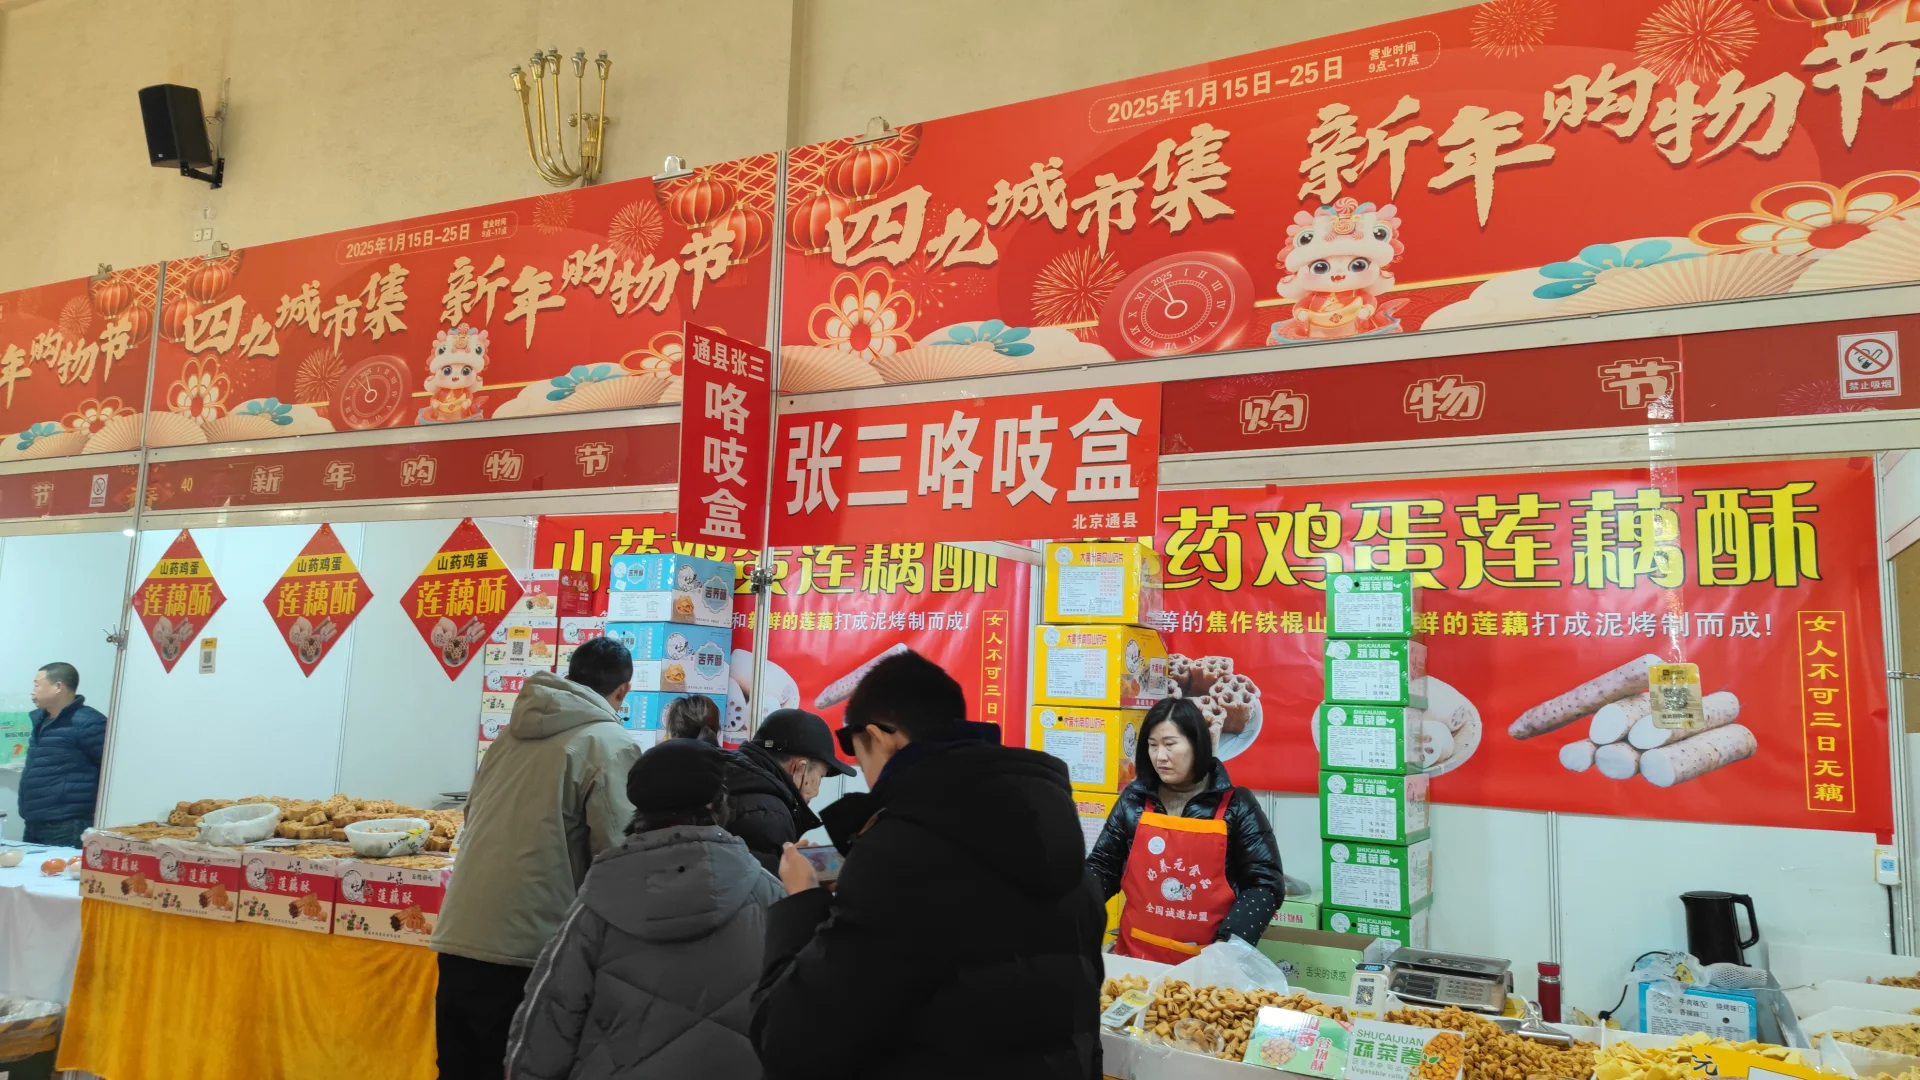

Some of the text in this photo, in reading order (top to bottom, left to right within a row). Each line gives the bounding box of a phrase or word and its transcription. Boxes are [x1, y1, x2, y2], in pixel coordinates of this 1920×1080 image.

[1368, 54, 1420, 73] 9点-17点
[1369, 41, 1416, 61] 营业时间
[1106, 55, 1344, 124] 2025年1月15日-25日
[824, 20, 1920, 269] 四九城市集 新年购物节
[482, 217, 507, 229] 营业时间
[345, 223, 470, 259] 2025年1月15日-25日
[182, 226, 736, 358] 四九城市集 新年购物节
[1150, 270, 1173, 287] 2025
[692, 334, 766, 382] 通县张三
[1849, 379, 1892, 391] 禁止吸烟
[699, 382, 751, 541] 咯吱盒
[785, 397, 1144, 516] 张三咯吱盒
[181, 477, 193, 492] 40
[1072, 511, 1138, 530] 北京通县
[1084, 481, 1822, 591] 药鸡蛋莲藕酥
[160, 561, 200, 576] 山药鸡蛋
[297, 556, 343, 573] 山药鸡蛋
[437, 551, 489, 571] 山药鸡蛋
[143, 582, 213, 617] 莲藕酥
[277, 578, 358, 618] 莲藕酥
[416, 574, 508, 619] 莲藕酥
[984, 613, 1005, 725] 女人不可三日
[1804, 614, 1845, 804] 女人不可三日无藕
[1145, 901, 1209, 922] 全国诚邀加盟
[1305, 966, 1347, 981] 舌尖的诱惑
[1356, 1028, 1425, 1048] SHUCAIJUAN
[1310, 1037, 1333, 1073] 谷物酥
[1352, 1038, 1424, 1067] 蔬菜卷
[1691, 1052, 1719, 1077] 元
[1351, 1065, 1387, 1078] Vegetable
[1388, 1071, 1404, 1080] rolls
